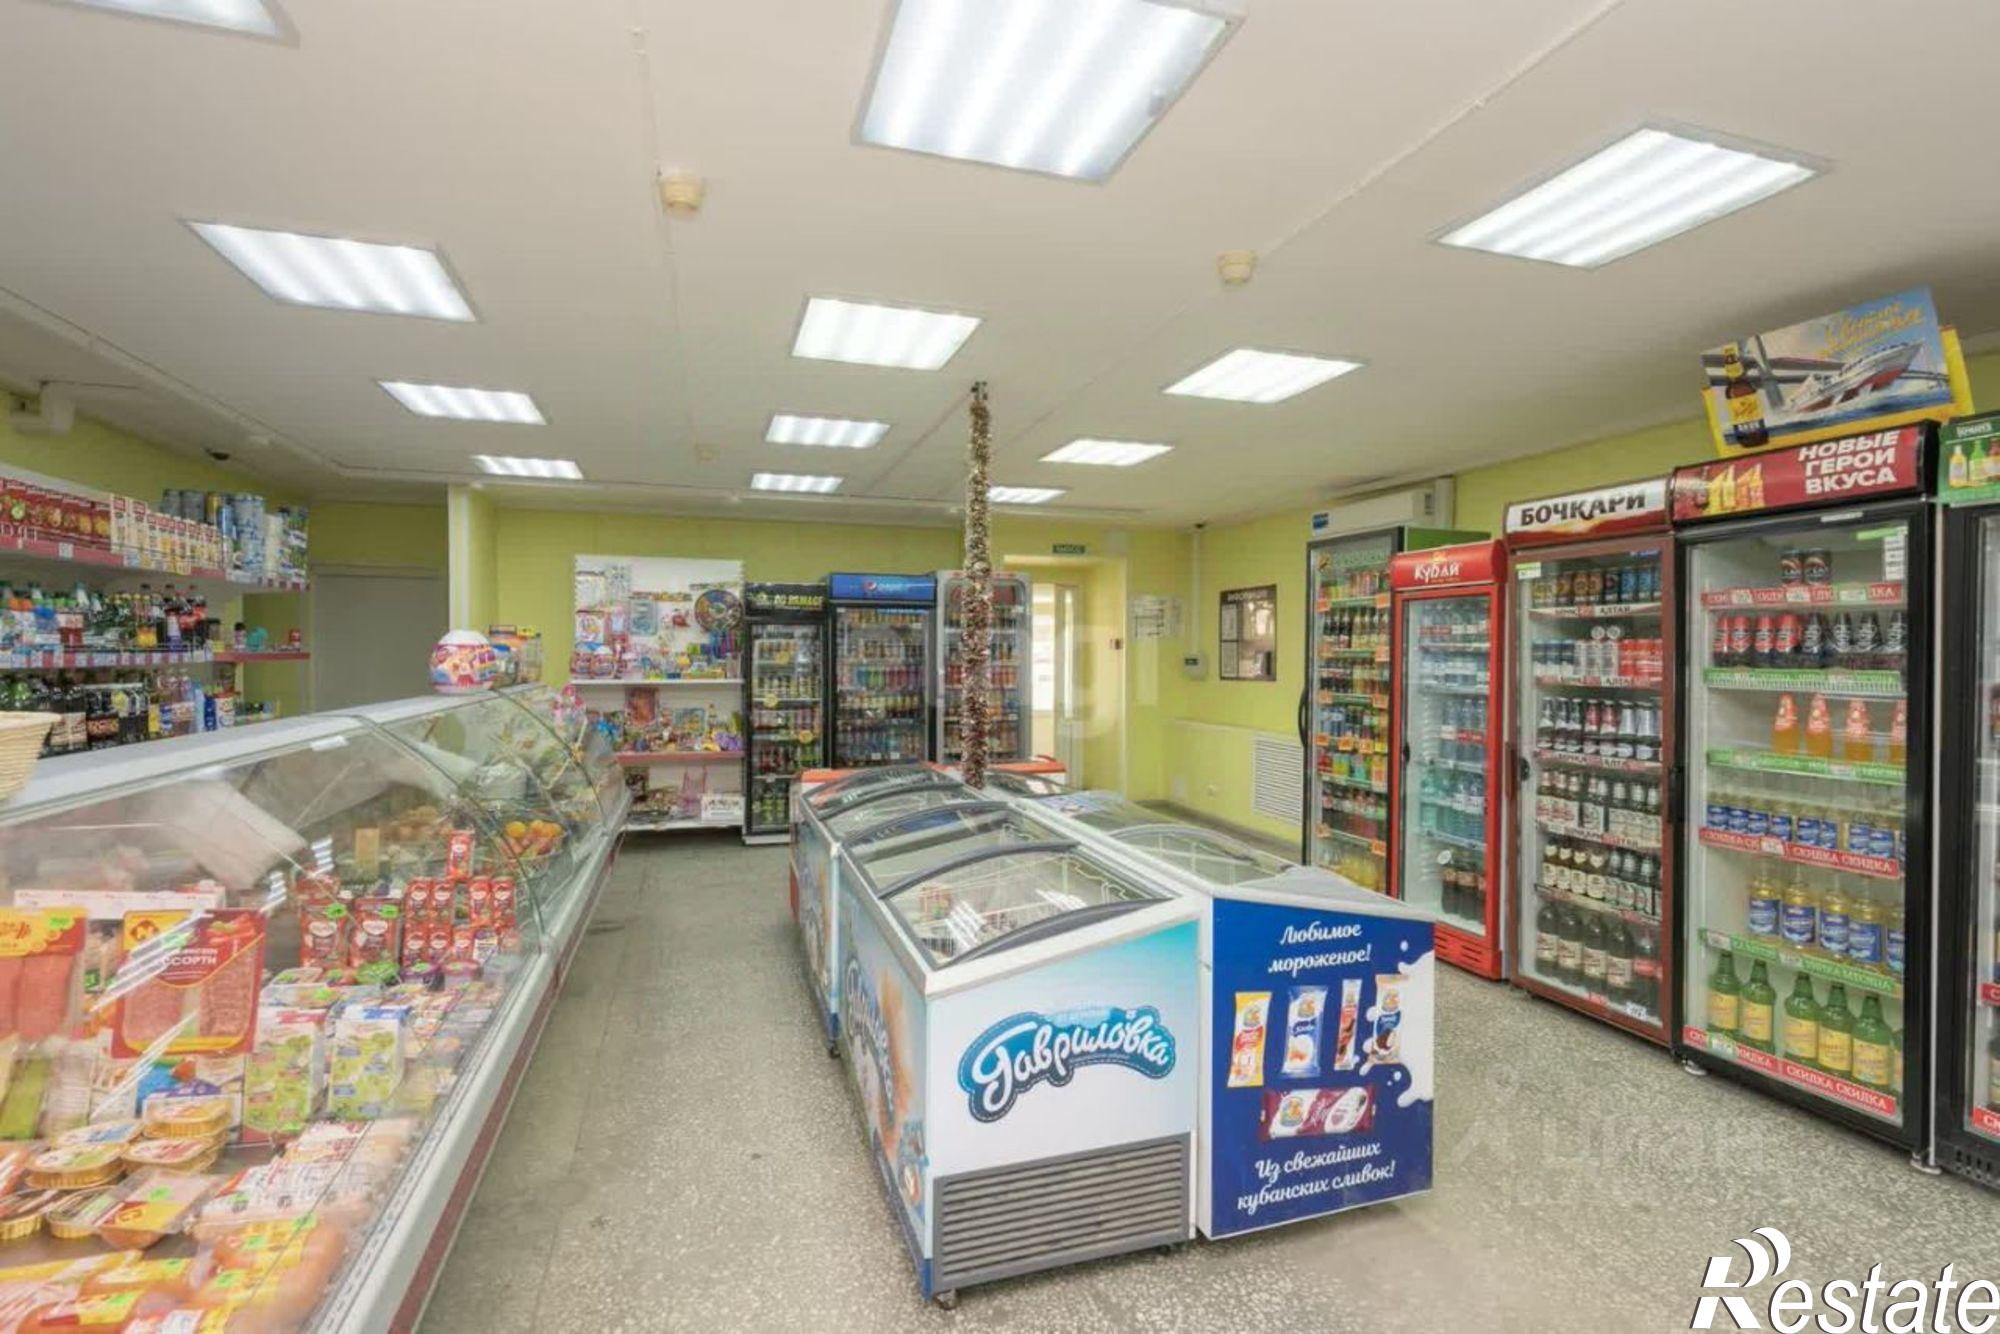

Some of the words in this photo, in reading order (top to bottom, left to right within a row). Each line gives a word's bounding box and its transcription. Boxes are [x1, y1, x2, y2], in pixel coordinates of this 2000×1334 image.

[1798, 430, 1899, 460] НОВЫЕ
[1804, 446, 1897, 477] ГЕРОИ
[1804, 466, 1897, 496] ВКУСА
[1520, 492, 1646, 527] БОЧКАРИ
[1793, 846, 1838, 865] СКИДКА
[1841, 853, 1893, 873] СКИДКА
[1280, 921, 1363, 947] Любимое
[1268, 945, 1371, 976] мороженое!
[970, 1014, 1169, 1113] Гавриловка
[1786, 1066, 1834, 1091] СКИДКА
[1836, 1082, 1887, 1110] СКИДКА
[1255, 1156, 1281, 1182] Из
[1284, 1141, 1383, 1176] свежайших
[1237, 1178, 1330, 1215] кубанских
[1332, 1160, 1396, 1194] сливок!
